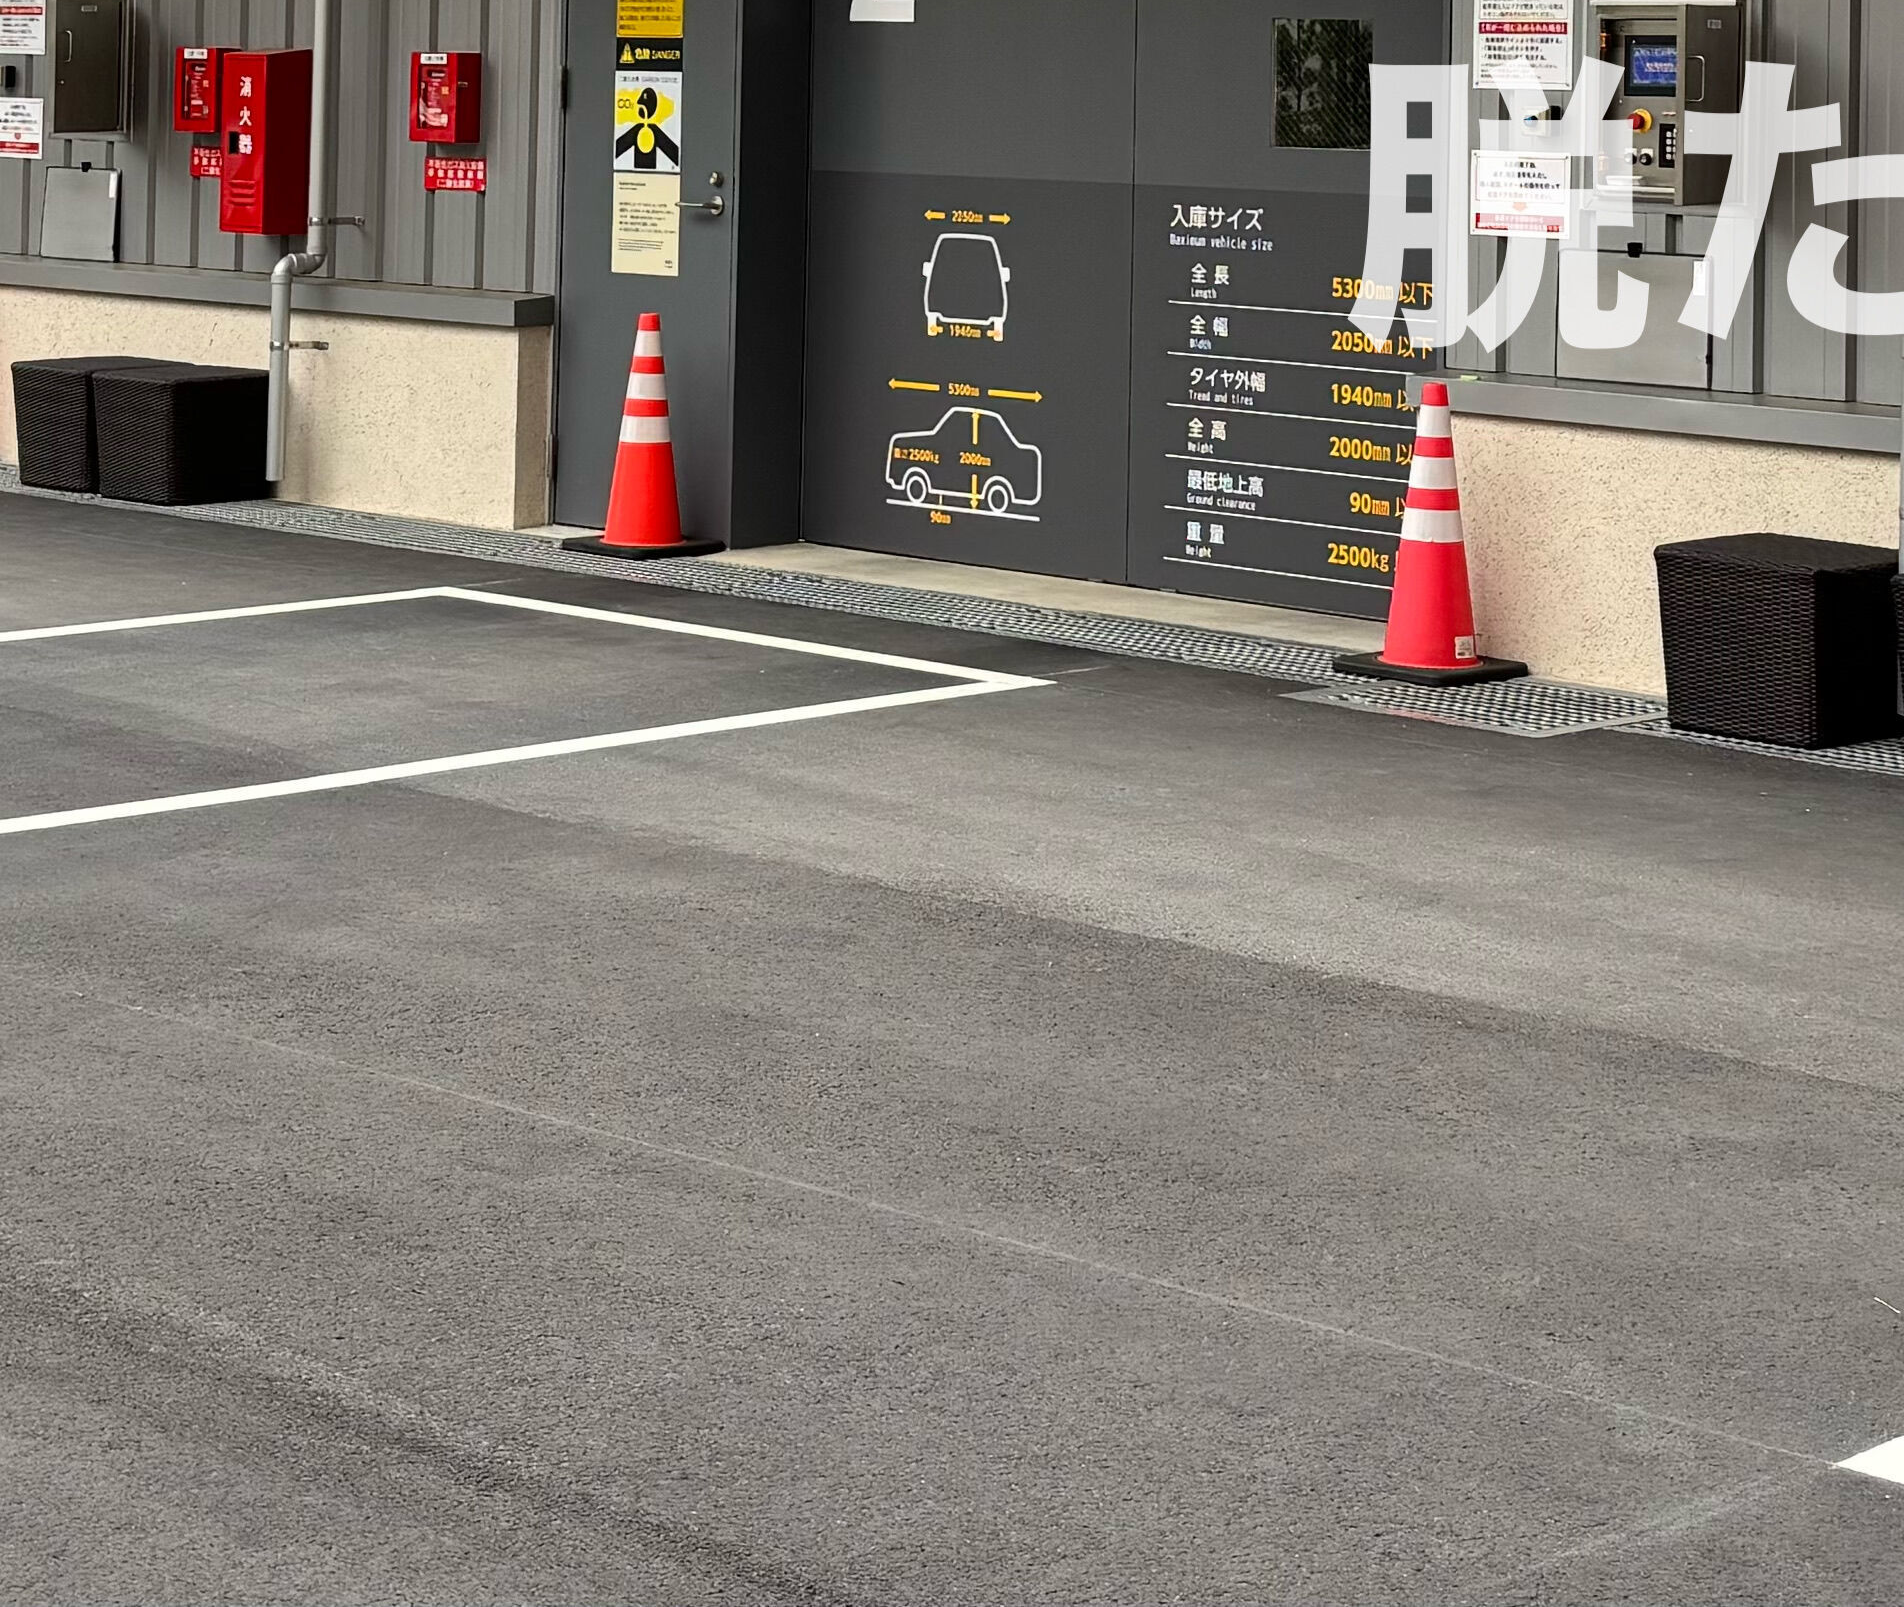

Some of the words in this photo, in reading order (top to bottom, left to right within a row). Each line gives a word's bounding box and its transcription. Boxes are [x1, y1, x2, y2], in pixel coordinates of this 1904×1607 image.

[239, 76, 252, 154] 消火器
[1170, 204, 1263, 231] 入庫サイズ
[1211, 235, 1246, 250] vehicle
[1252, 237, 1273, 251] size
[1191, 263, 1229, 285] 全長
[1332, 277, 1393, 300] 5300mm
[1398, 281, 1435, 305] 以下
[1190, 314, 1229, 337] 全幅
[1331, 330, 1392, 354] 2050mm
[1397, 336, 1434, 360] 以下
[1190, 368, 1266, 392] タイヤ外幅
[1214, 392, 1228, 403] and
[1231, 393, 1253, 406] tires
[1331, 383, 1391, 408] 1940mm
[1188, 418, 1227, 440] 全高
[1329, 436, 1391, 462] 2000mm
[1188, 469, 1263, 497] 最低地上高
[1187, 493, 1213, 506] Ground
[1350, 492, 1389, 516] 90mm
[1187, 521, 1224, 544] 重量
[1328, 543, 1389, 572] 2500kg
